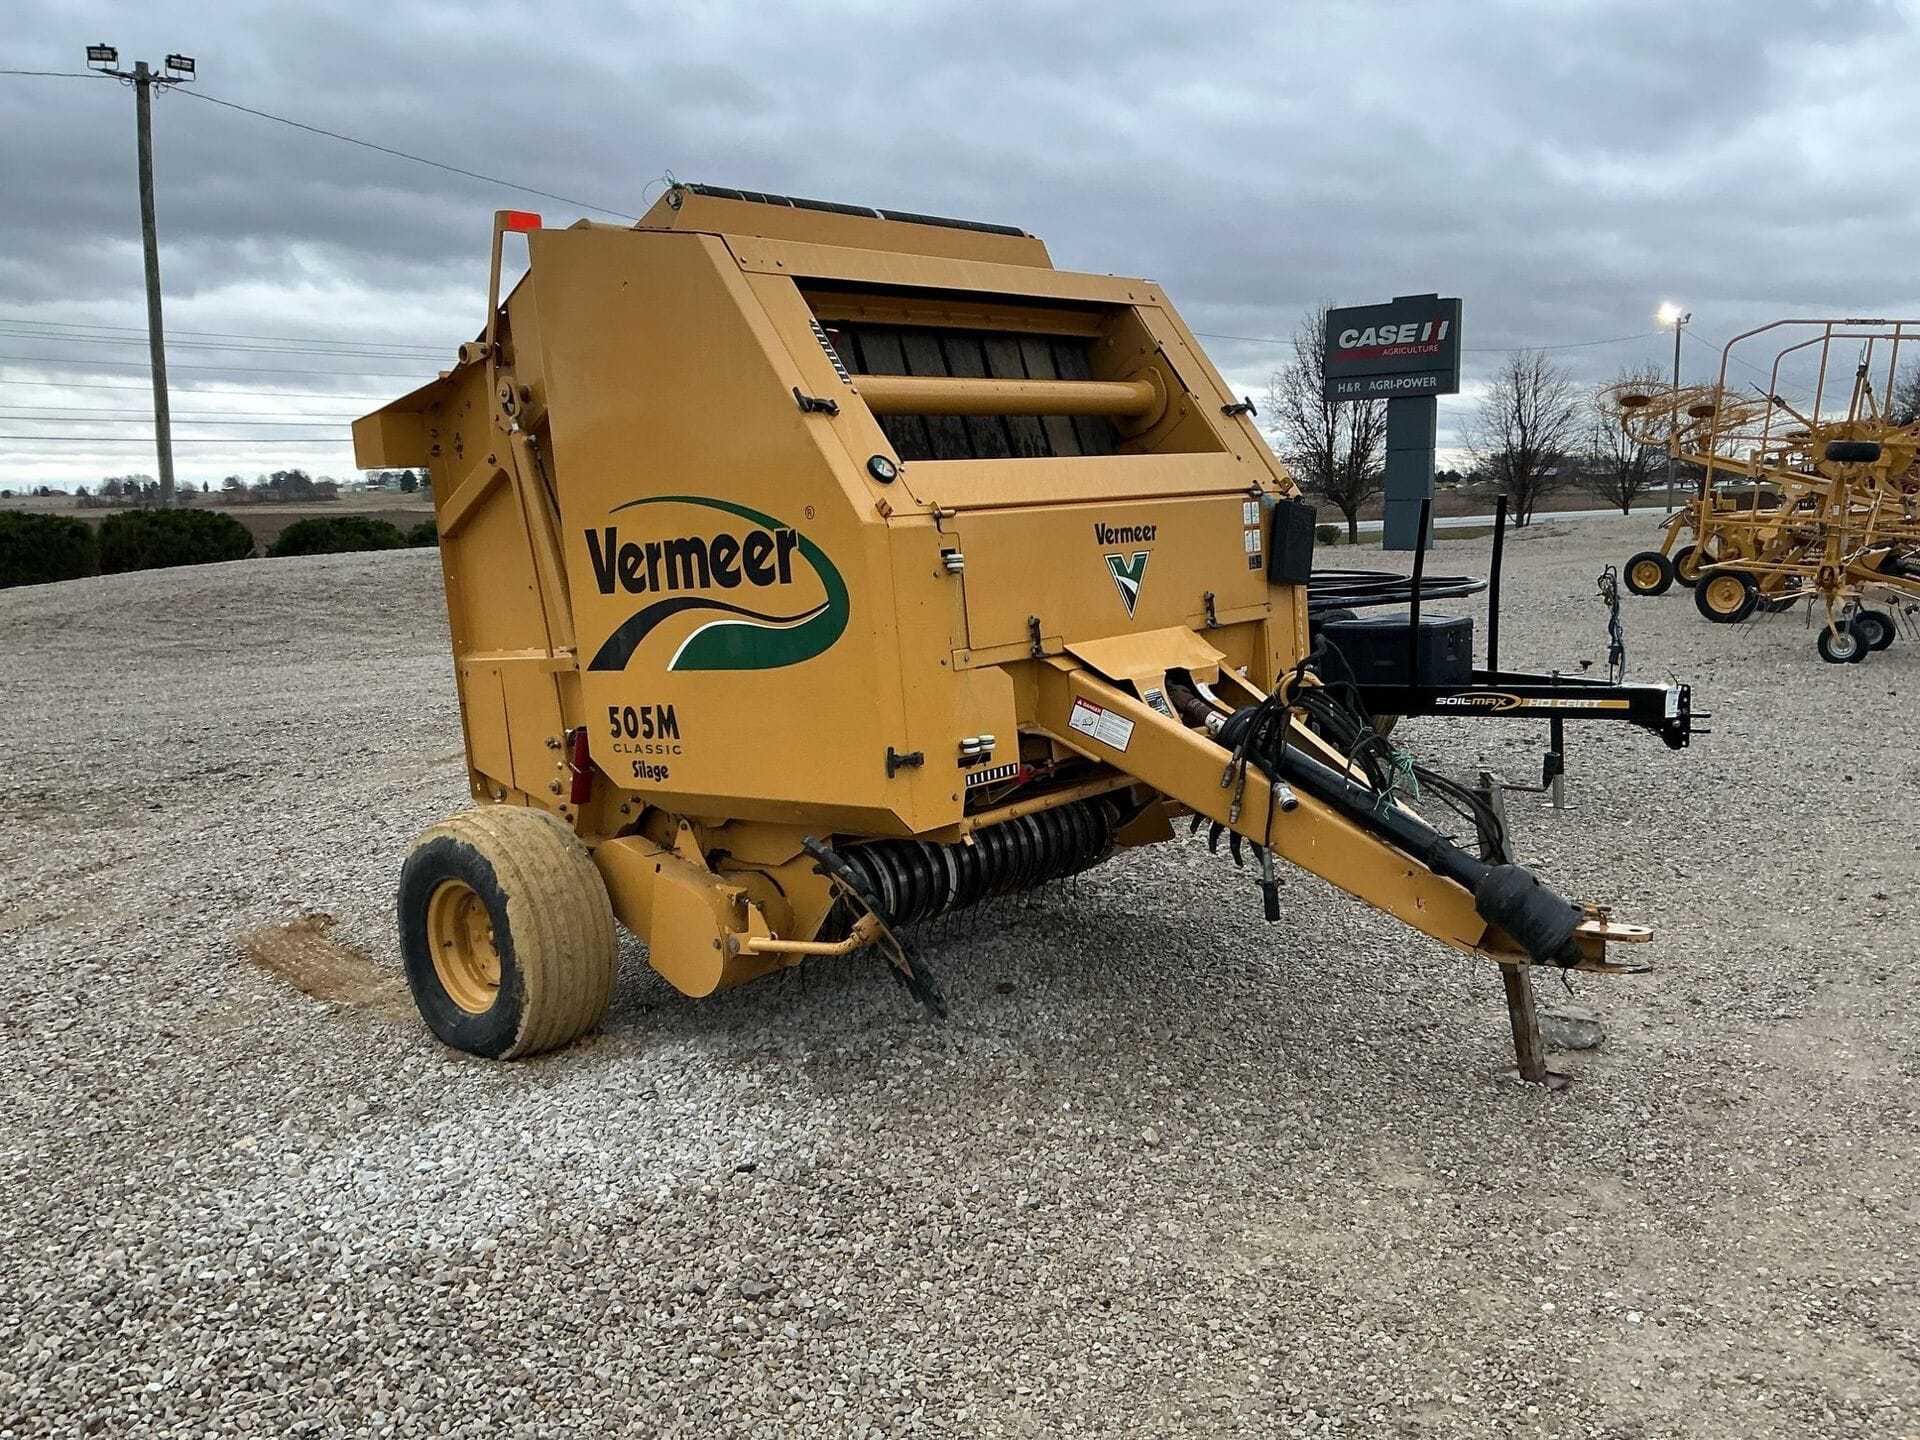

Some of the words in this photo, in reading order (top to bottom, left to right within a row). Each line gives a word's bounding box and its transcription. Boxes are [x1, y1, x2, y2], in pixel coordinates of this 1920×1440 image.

[1338, 323, 1418, 349] CASE
[1382, 344, 1439, 356] AGRICULTURE
[1338, 381, 1361, 393] H&R
[1368, 376, 1437, 391] AGRI-POWER
[1094, 522, 1157, 545] Vermeer
[583, 526, 799, 595] Vermeer
[1529, 698, 1552, 708] HD
[1556, 699, 1601, 708] CART
[608, 703, 681, 740] 505M
[613, 743, 682, 755] CLASSIC
[632, 760, 669, 783] Silage
